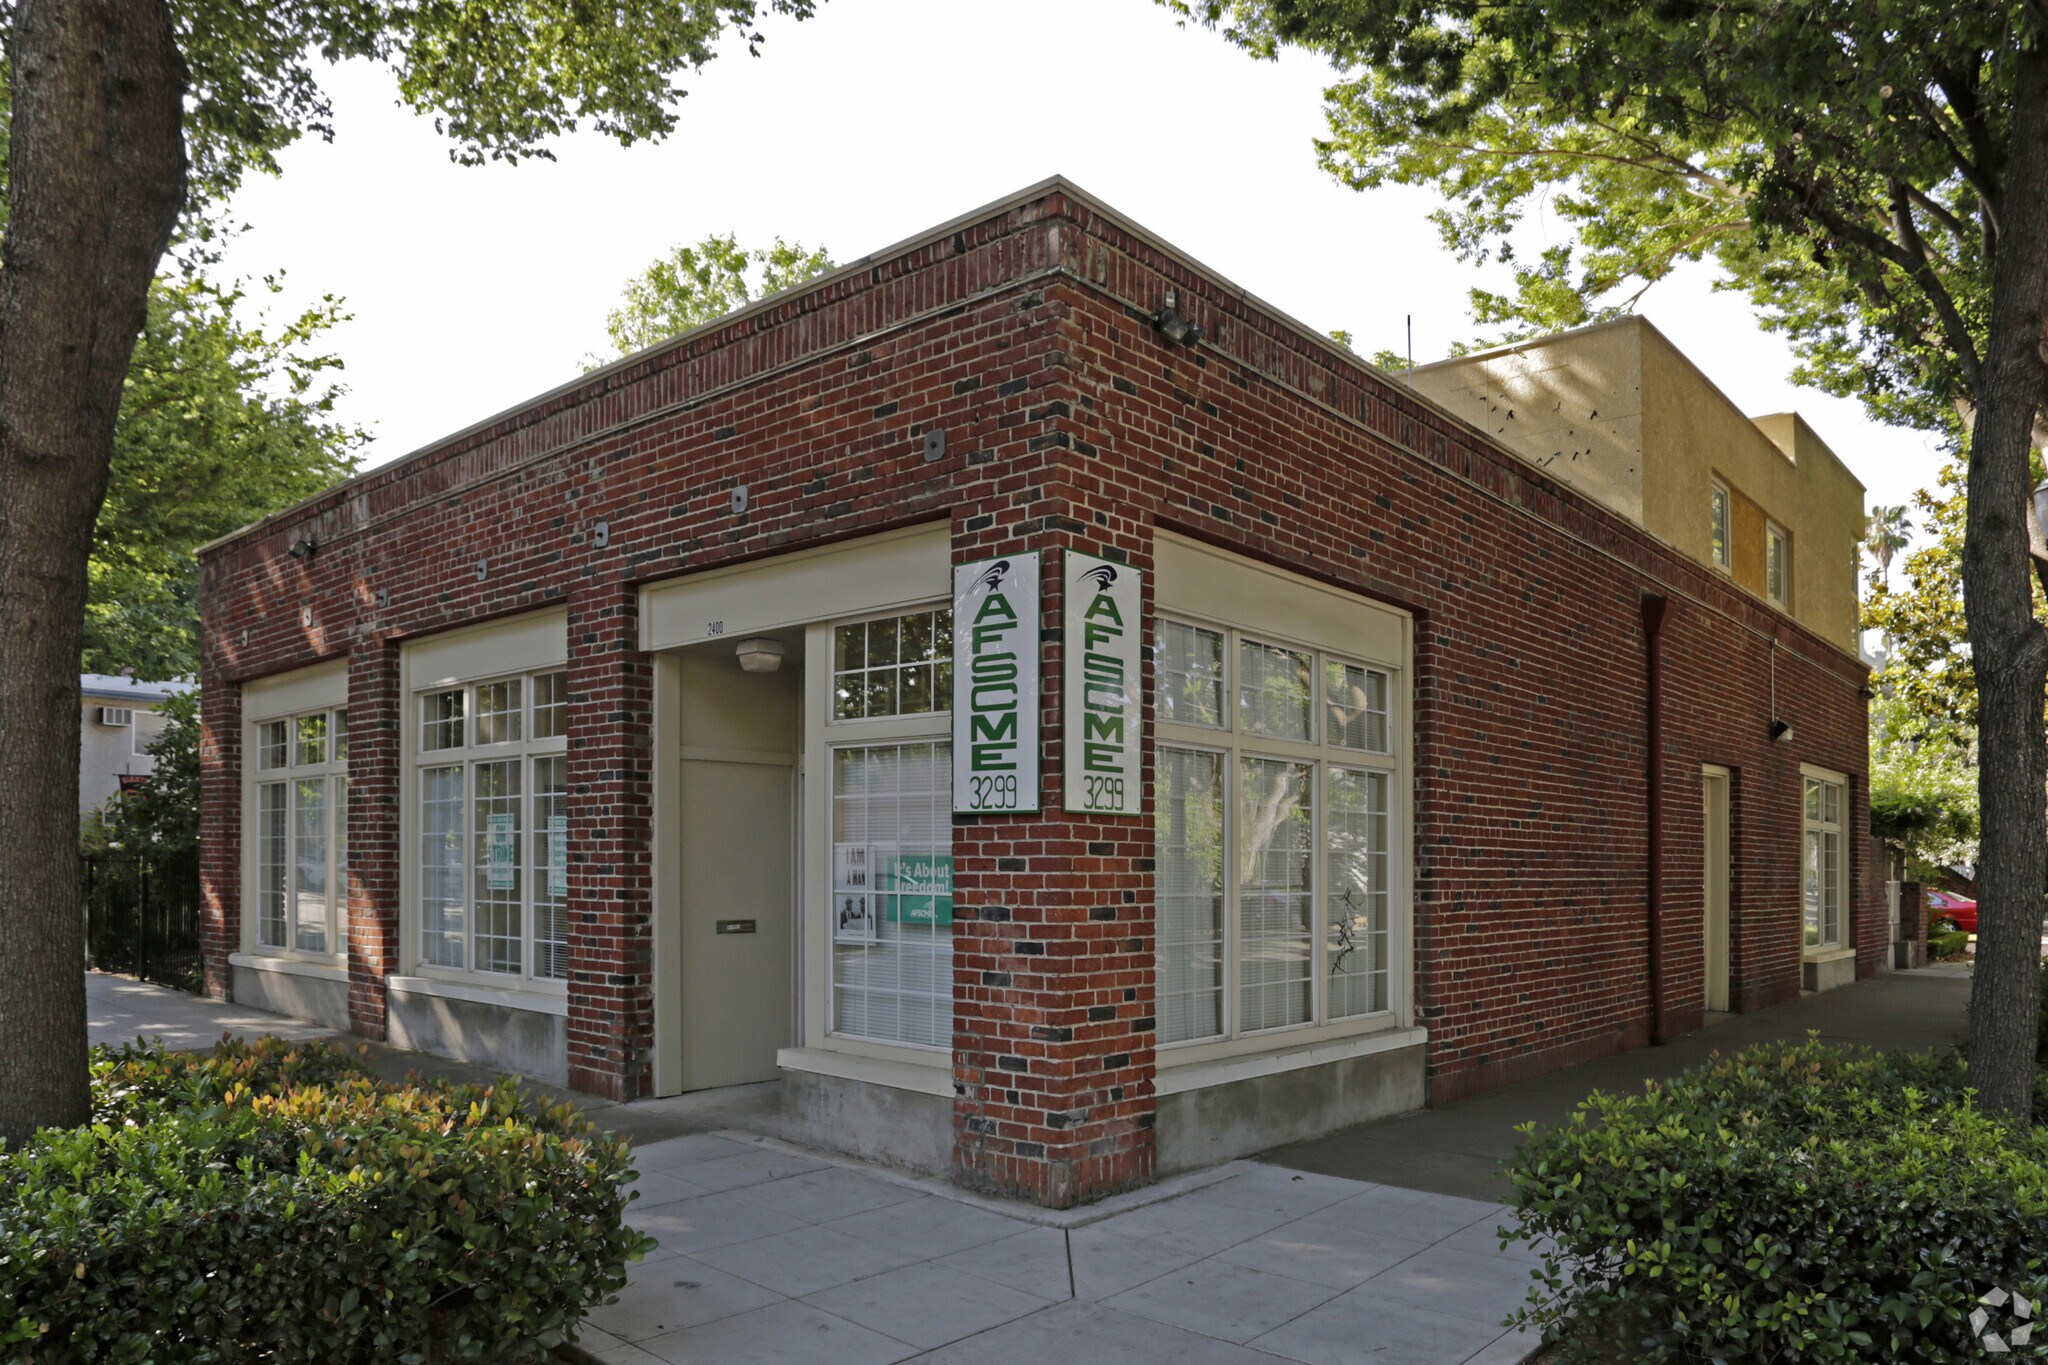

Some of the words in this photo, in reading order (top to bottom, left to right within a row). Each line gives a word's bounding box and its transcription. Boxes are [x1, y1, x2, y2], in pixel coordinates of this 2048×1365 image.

[707, 620, 724, 636] 2400
[971, 592, 1018, 772] AFSCME
[1084, 593, 1124, 774] AFSCME
[970, 774, 1018, 810] 3299
[1083, 774, 1124, 811] 3299
[851, 848, 866, 865] AM
[847, 869, 851, 886] A
[914, 862, 950, 878] About
